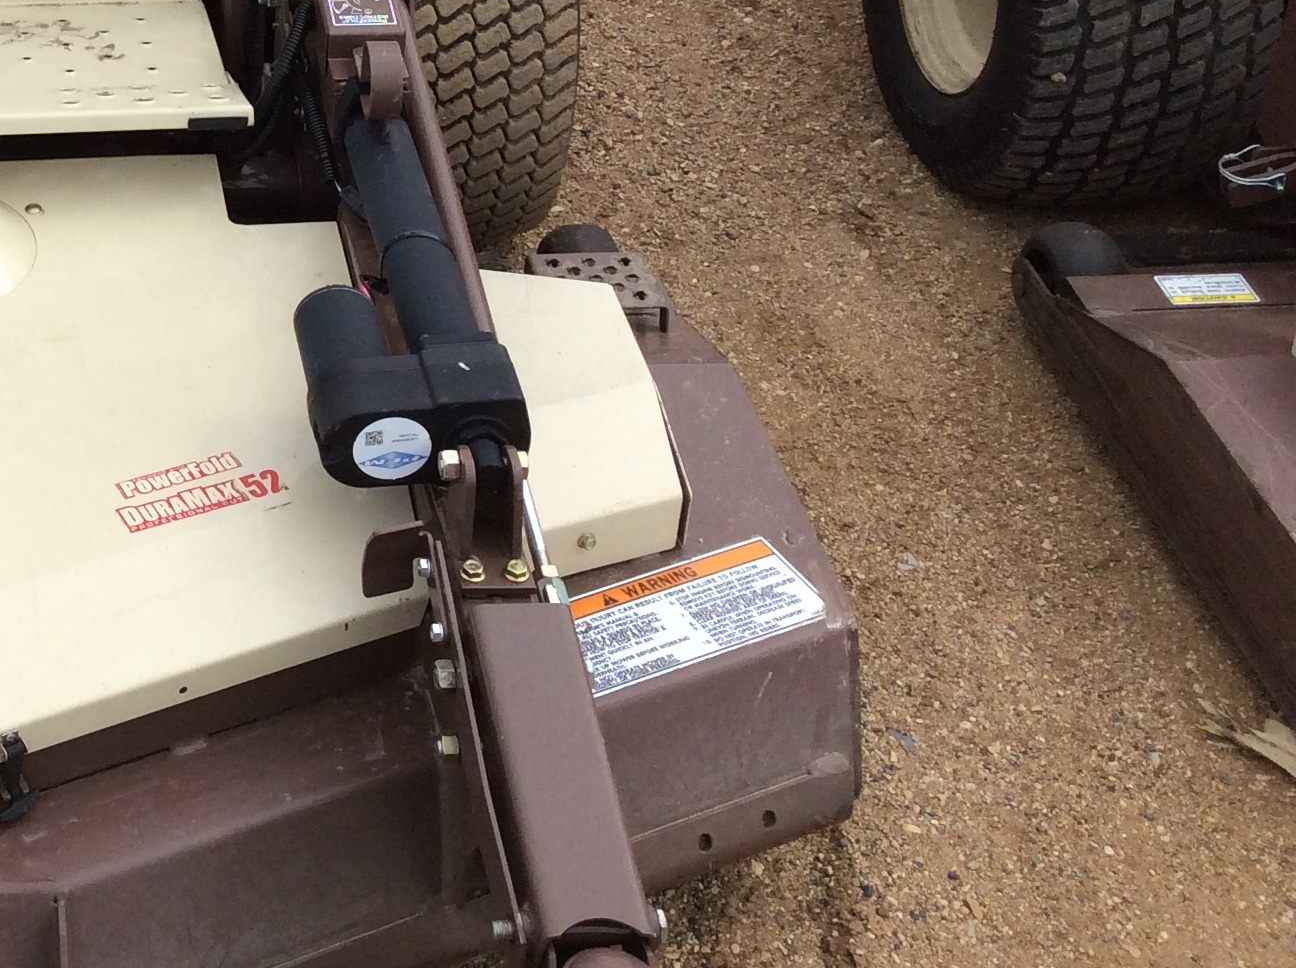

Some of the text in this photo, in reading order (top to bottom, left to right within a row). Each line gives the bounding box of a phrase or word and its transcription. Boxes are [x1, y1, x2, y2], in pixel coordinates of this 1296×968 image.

[116, 452, 242, 499] PowerFold
[239, 469, 281, 498] 52
[620, 566, 698, 599] WARNING
[589, 611, 616, 623] INJURY
[617, 605, 634, 614] CAN
[634, 594, 663, 608] RESULT
